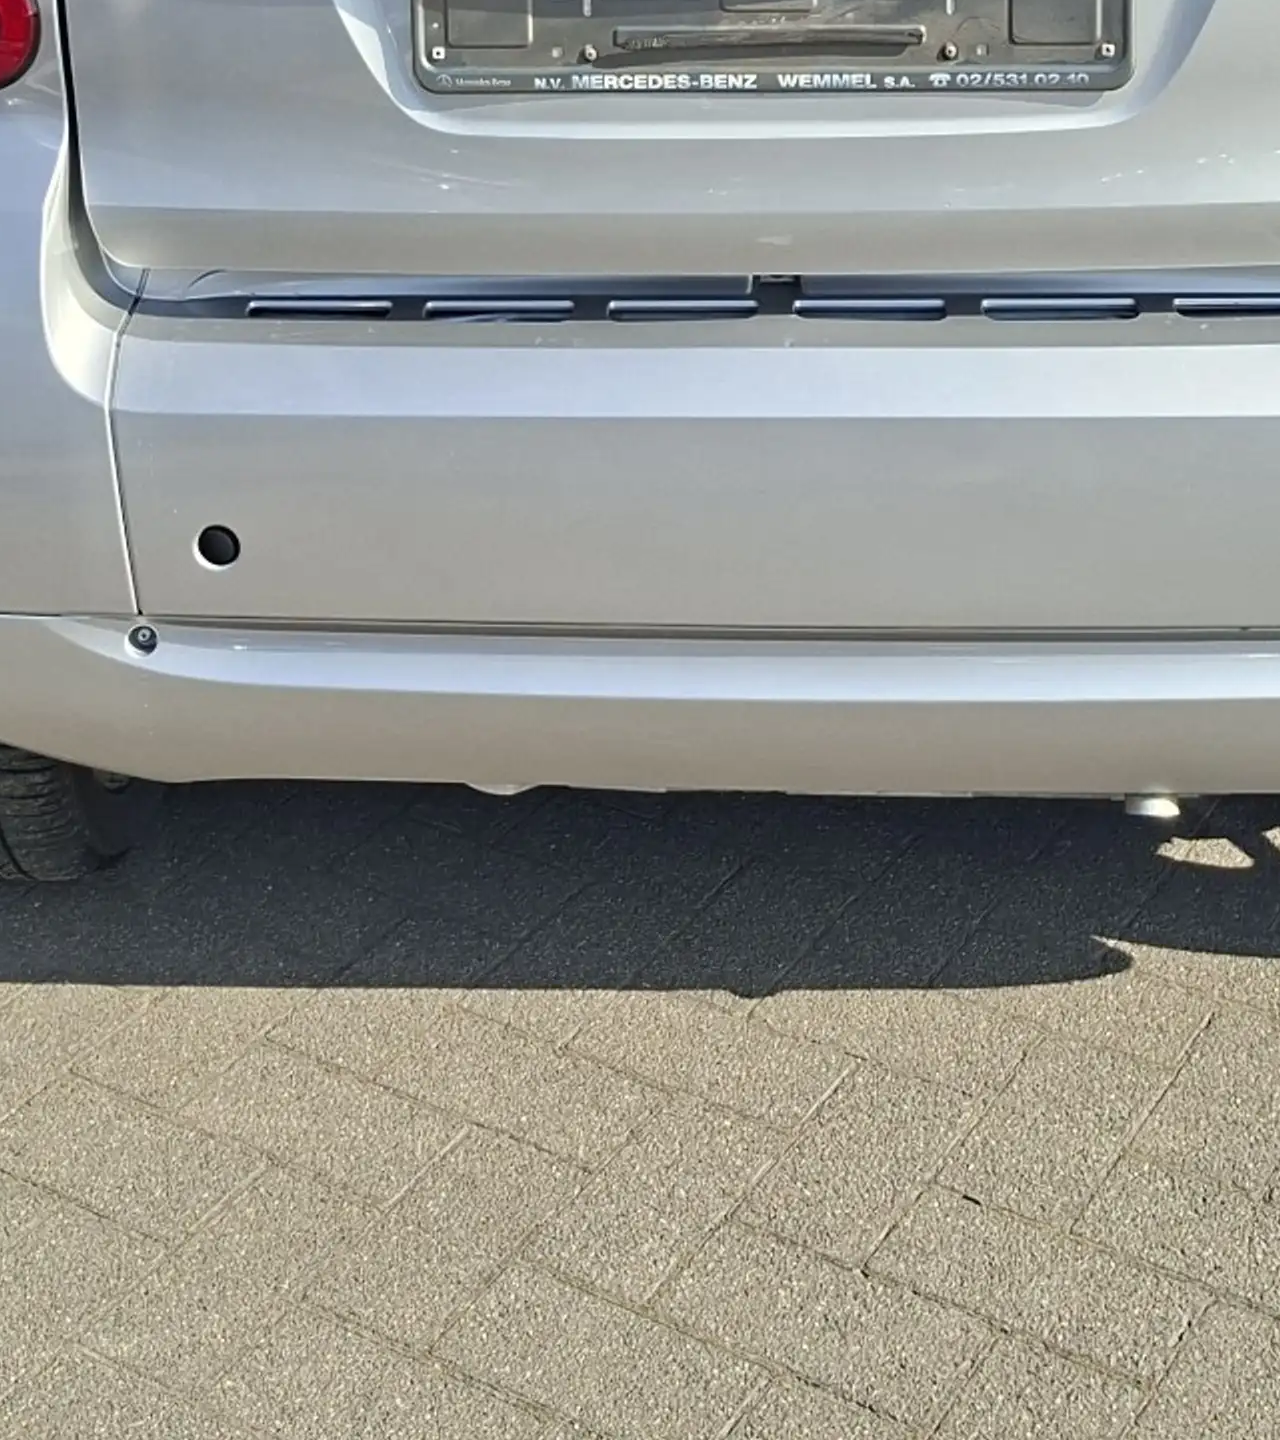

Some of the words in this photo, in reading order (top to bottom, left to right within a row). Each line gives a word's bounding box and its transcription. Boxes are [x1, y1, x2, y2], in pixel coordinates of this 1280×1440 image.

[534, 76, 567, 90] N.V.
[571, 73, 758, 90] MERCEDES-BENZ
[777, 73, 878, 89] WEMMEL
